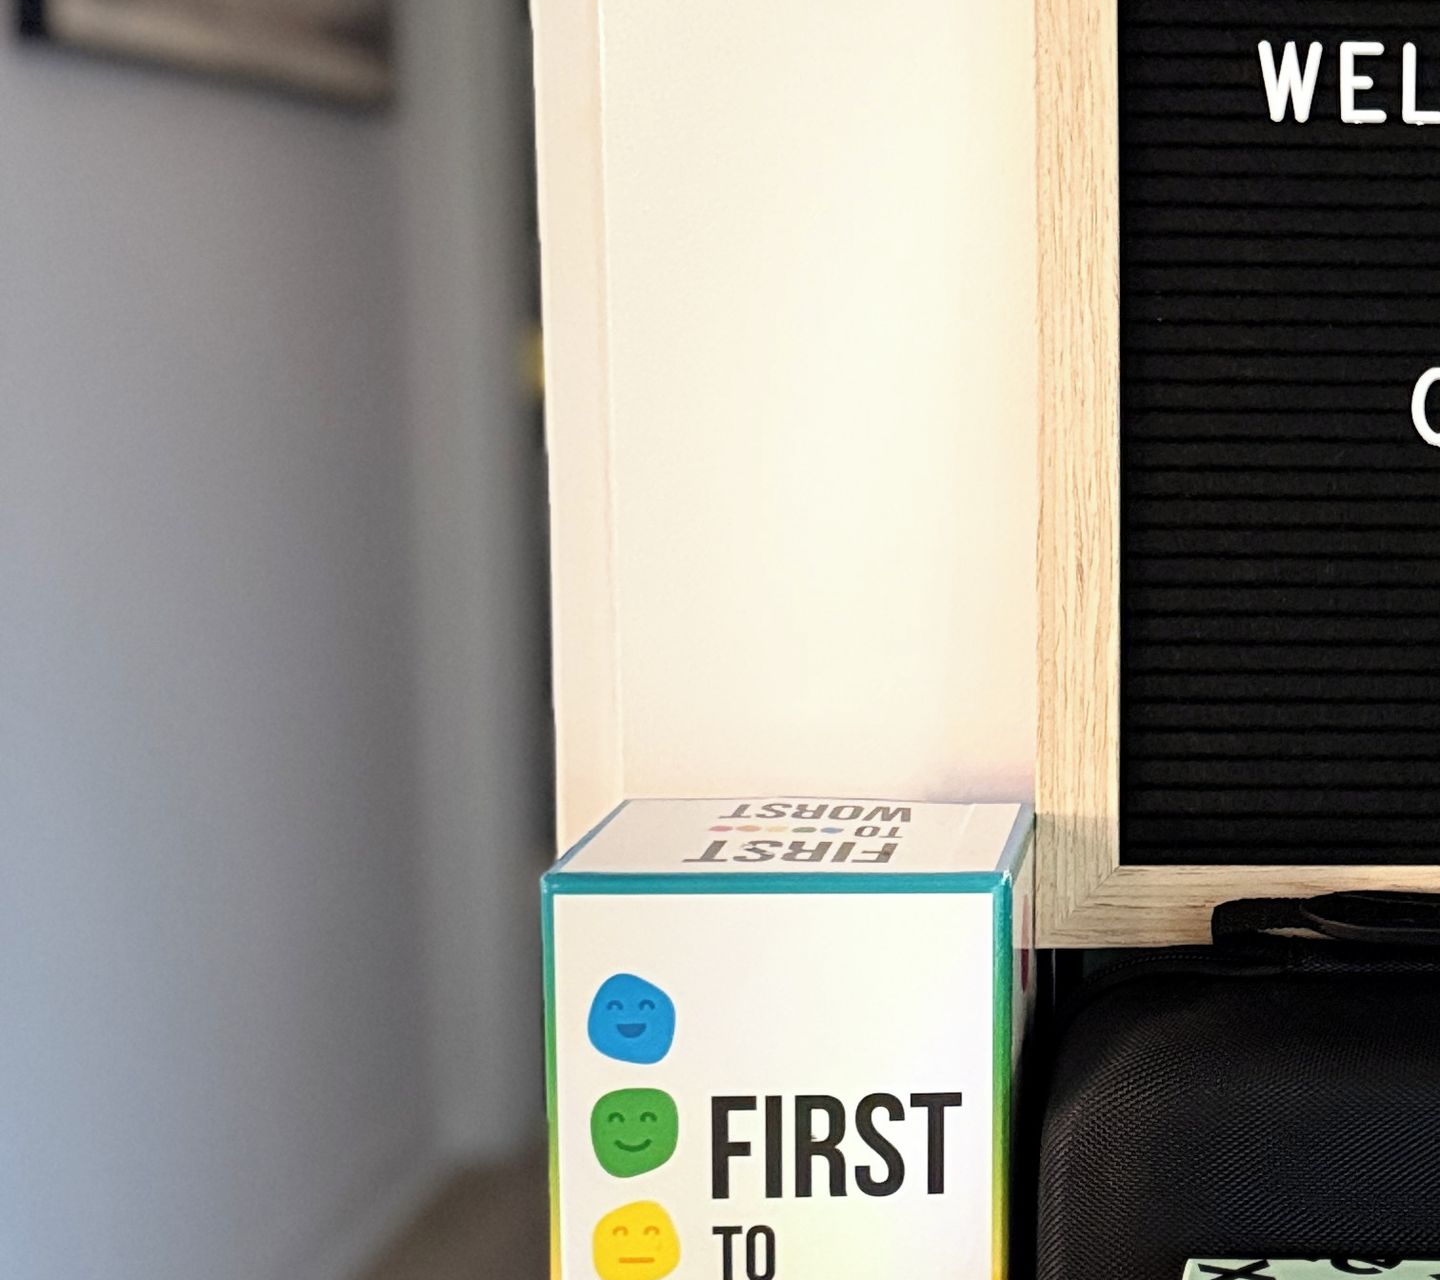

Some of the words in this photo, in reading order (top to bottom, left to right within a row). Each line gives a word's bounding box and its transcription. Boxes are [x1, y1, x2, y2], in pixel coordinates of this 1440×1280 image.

[718, 803, 912, 823] WORST
[854, 825, 904, 839] TO
[681, 840, 899, 864] FIRST
[711, 1092, 963, 1200] FIRST
